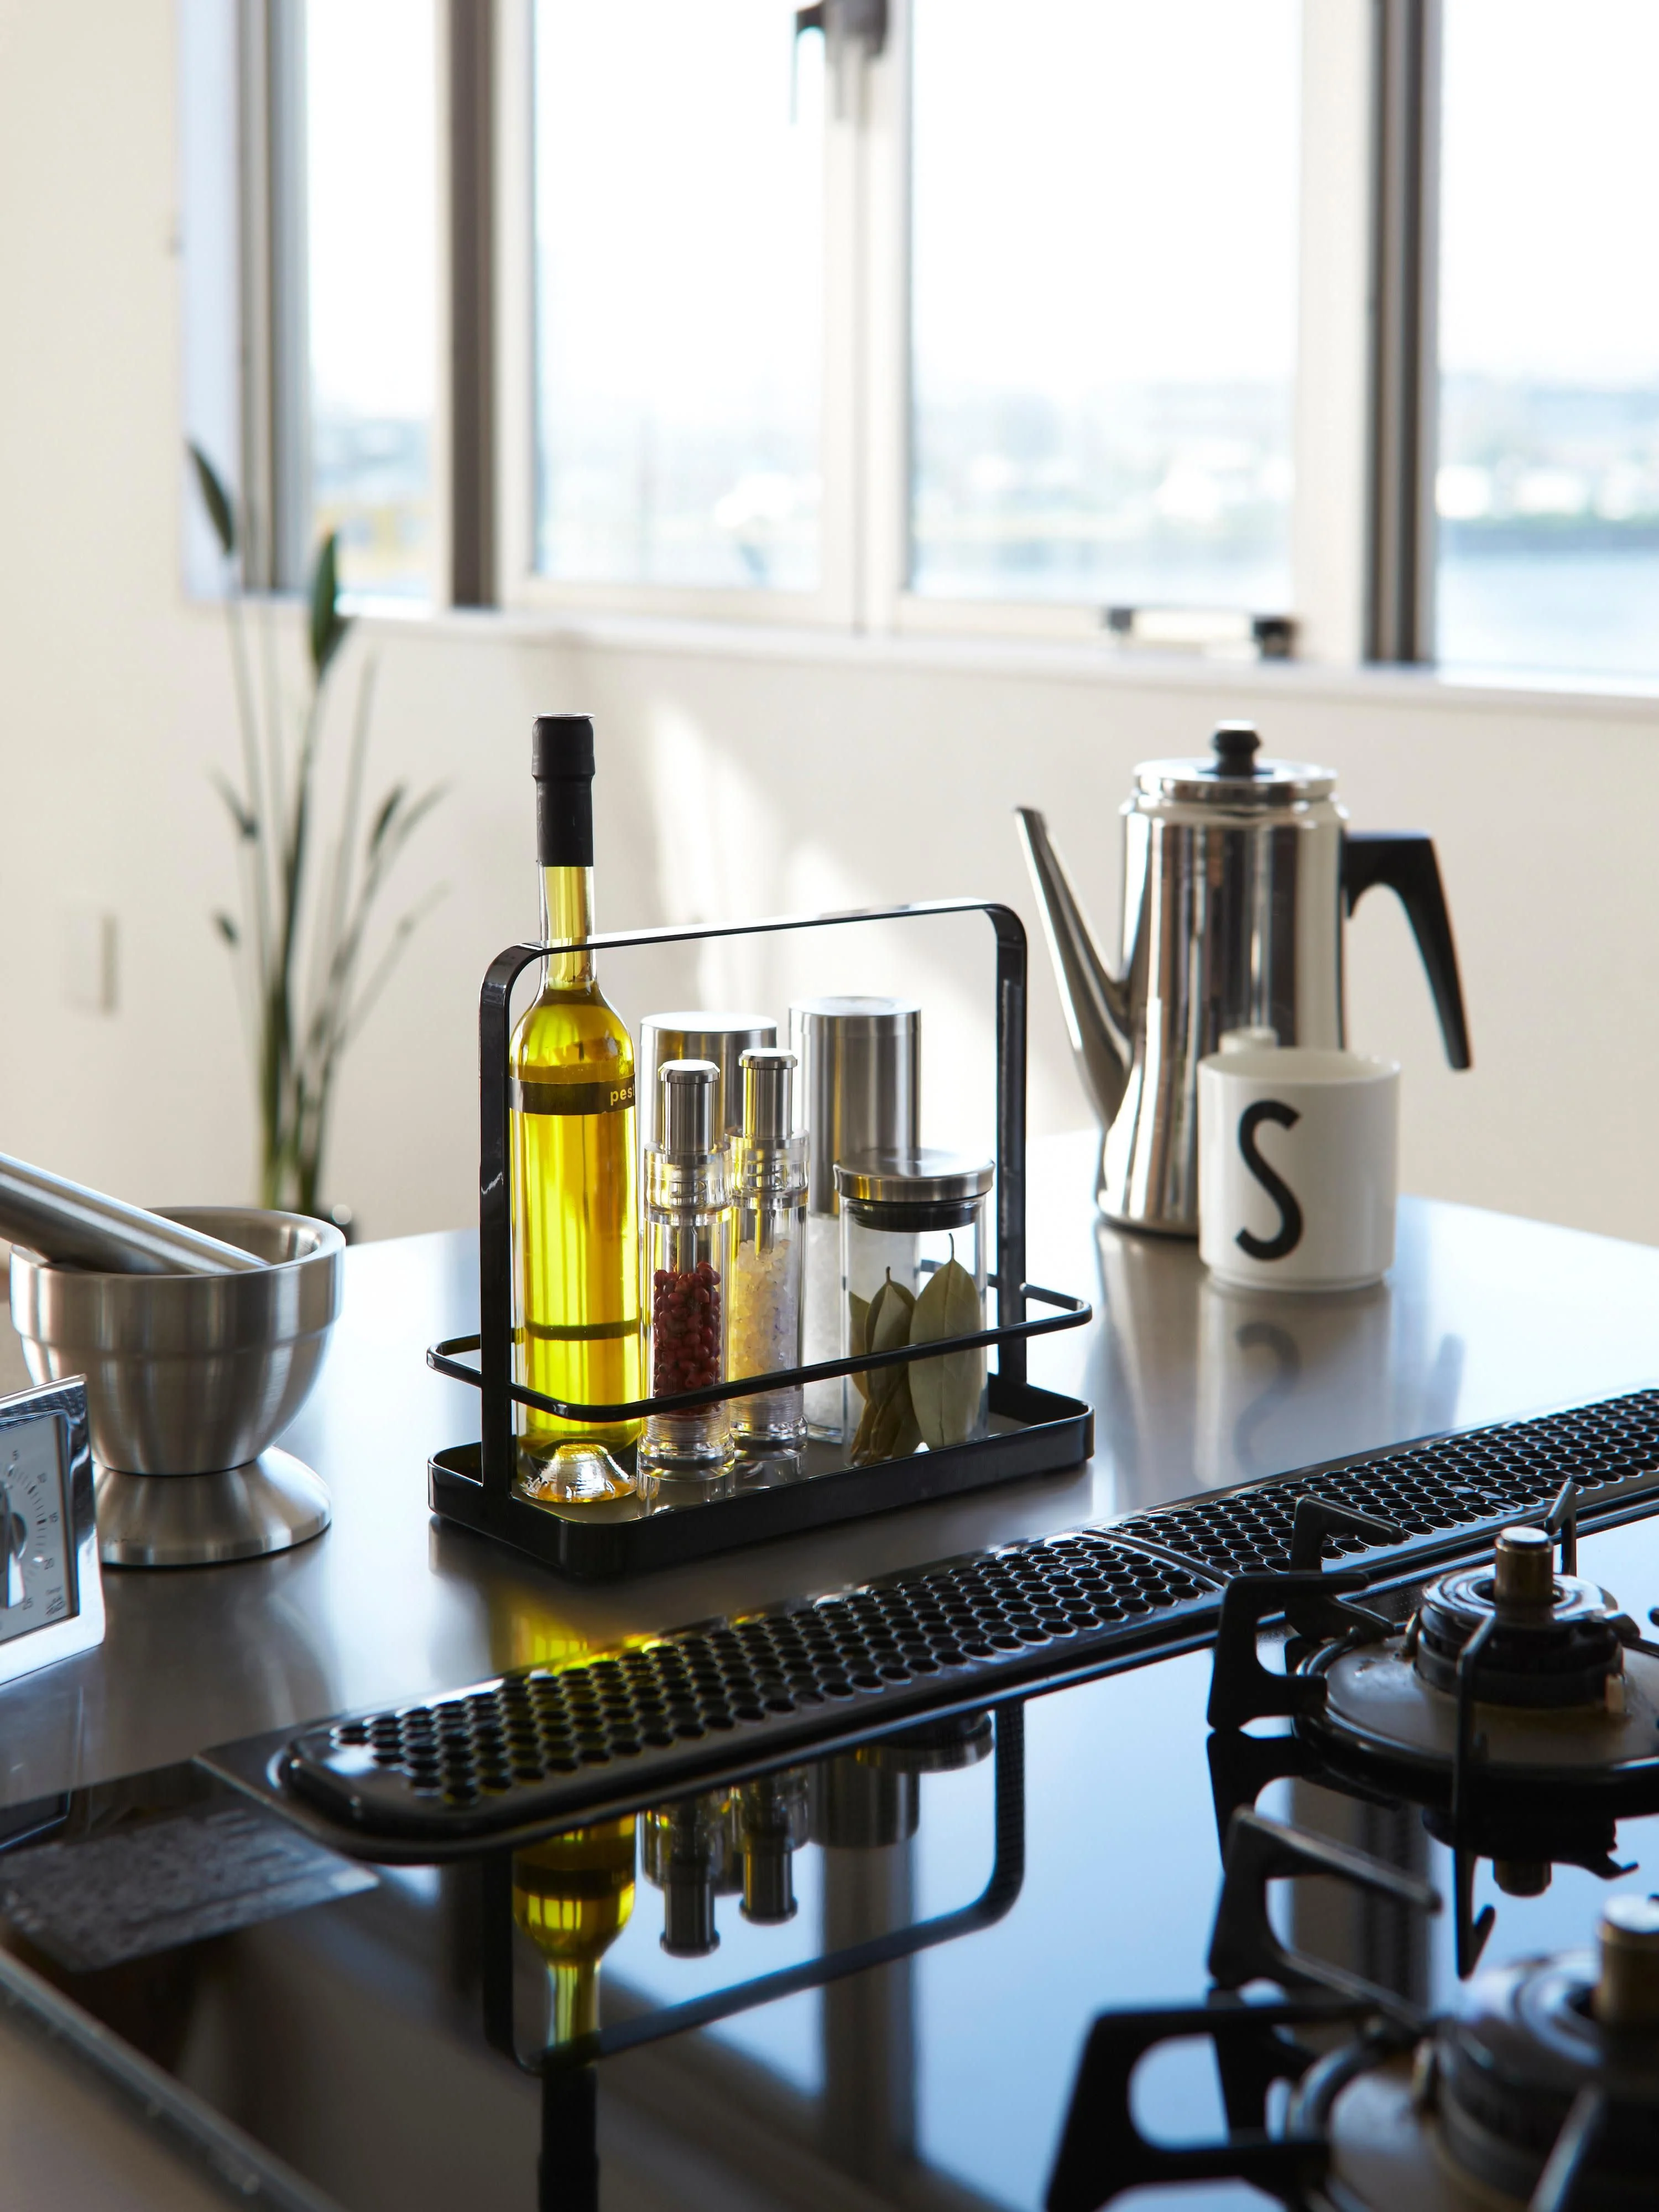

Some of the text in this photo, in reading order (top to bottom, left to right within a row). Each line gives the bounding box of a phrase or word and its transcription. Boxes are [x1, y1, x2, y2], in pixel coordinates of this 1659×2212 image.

[1235, 1099, 1303, 1261] S
[48, 1512, 59, 1523] 15
[44, 1557, 55, 1571] 20
